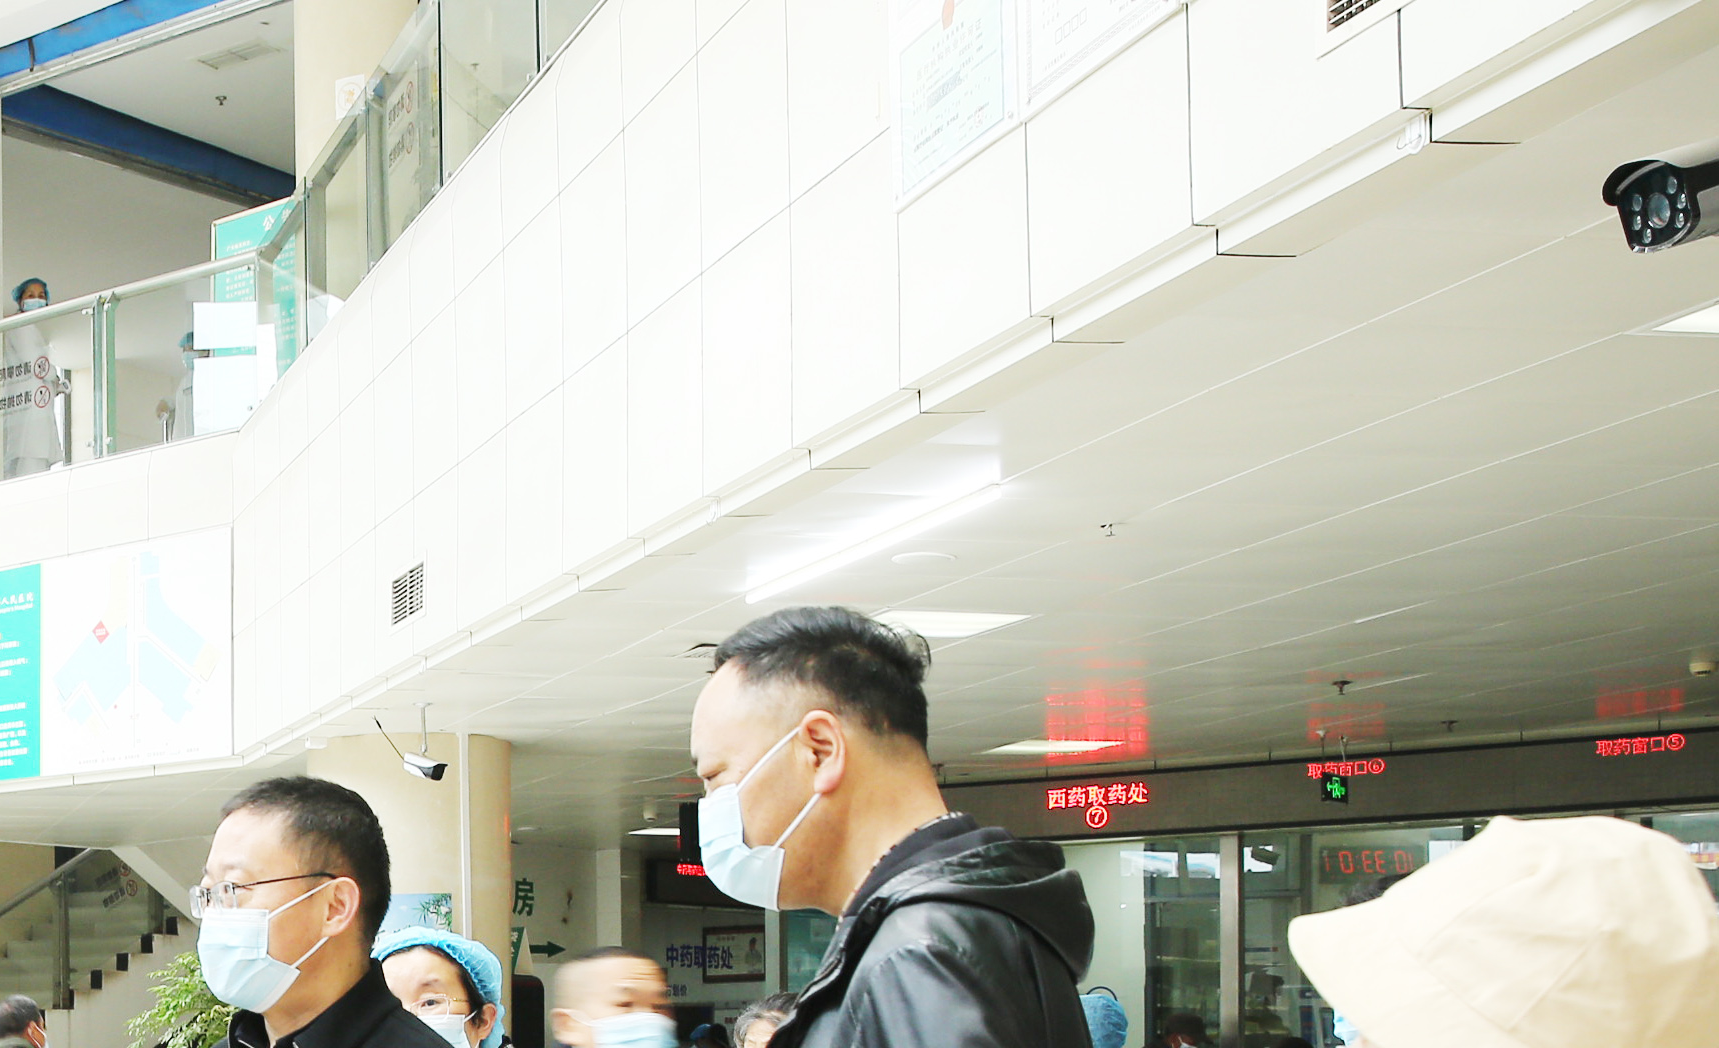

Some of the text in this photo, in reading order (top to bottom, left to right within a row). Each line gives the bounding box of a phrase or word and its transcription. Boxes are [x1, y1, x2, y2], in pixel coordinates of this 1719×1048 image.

[1047, 782, 1149, 810] 西药取药处
[512, 878, 535, 917] 房
[666, 943, 734, 970] 中药取药处
